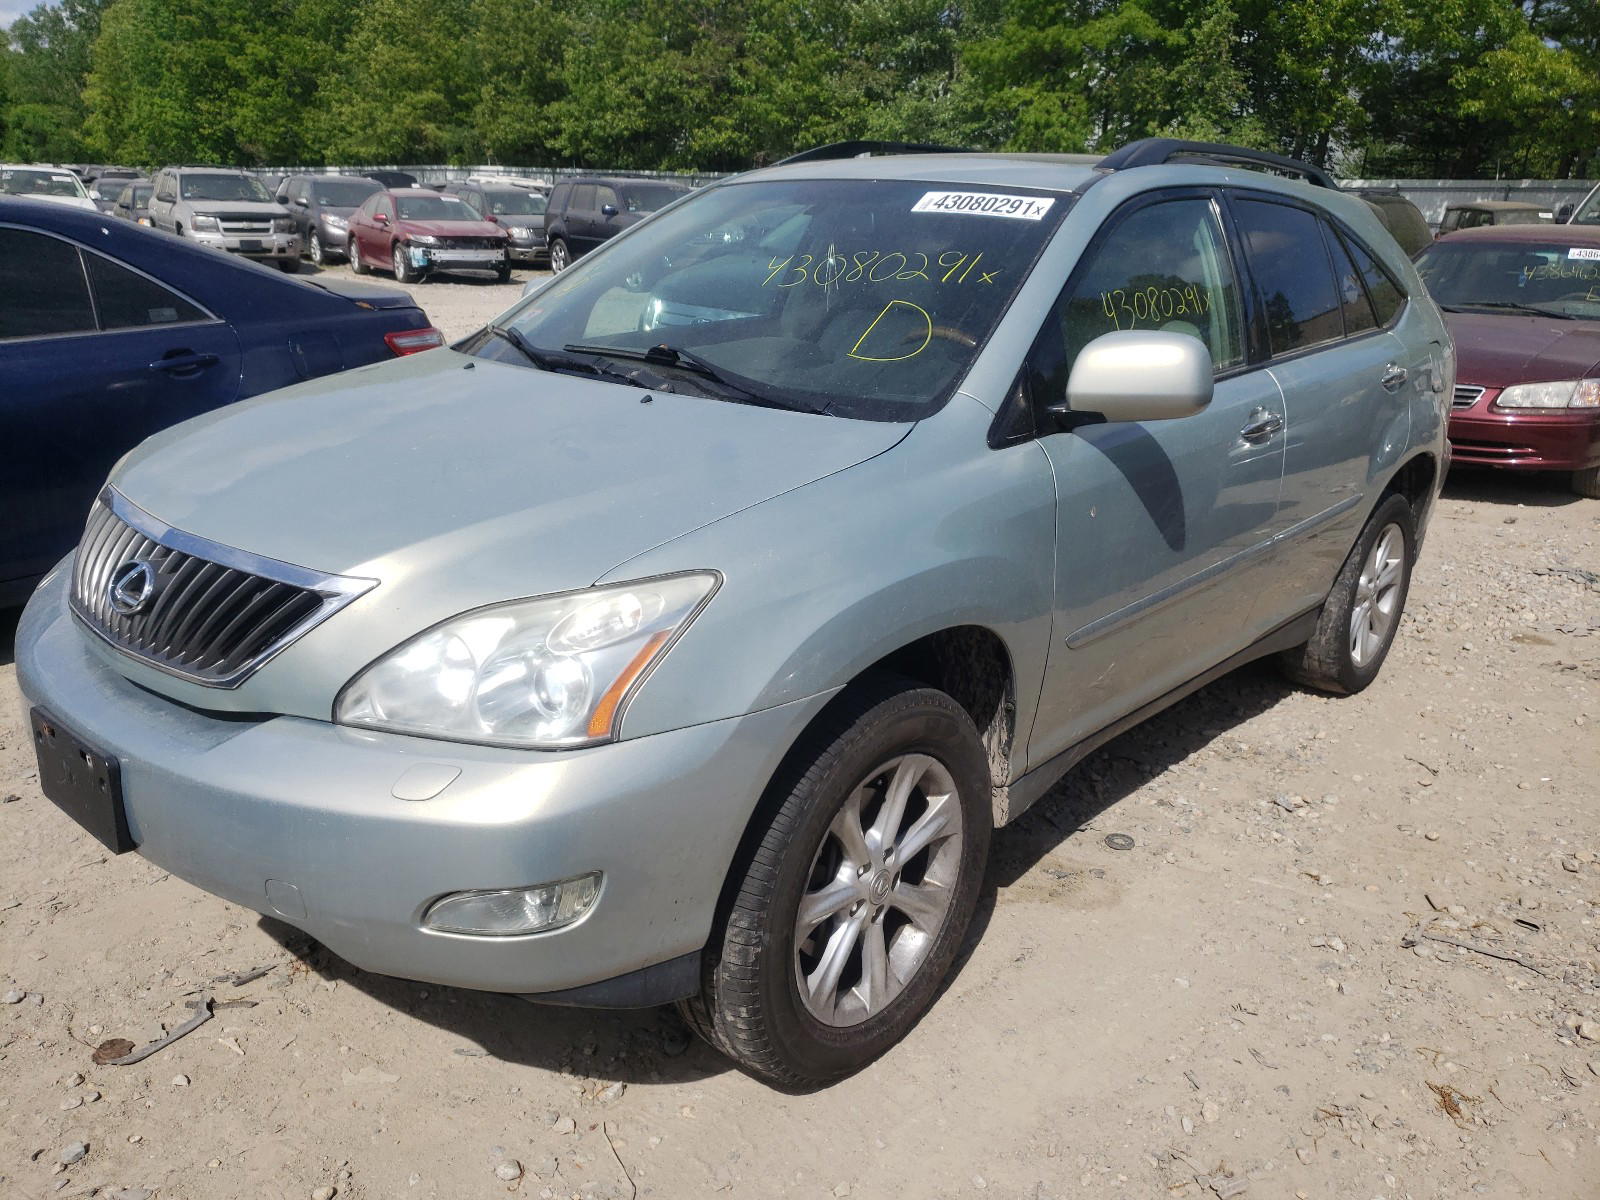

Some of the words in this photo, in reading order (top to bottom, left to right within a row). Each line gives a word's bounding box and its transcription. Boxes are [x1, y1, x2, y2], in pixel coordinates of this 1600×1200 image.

[933, 194, 1045, 216] 43080291x
[1576, 249, 1600, 259] 4386
[847, 299, 933, 361] D
